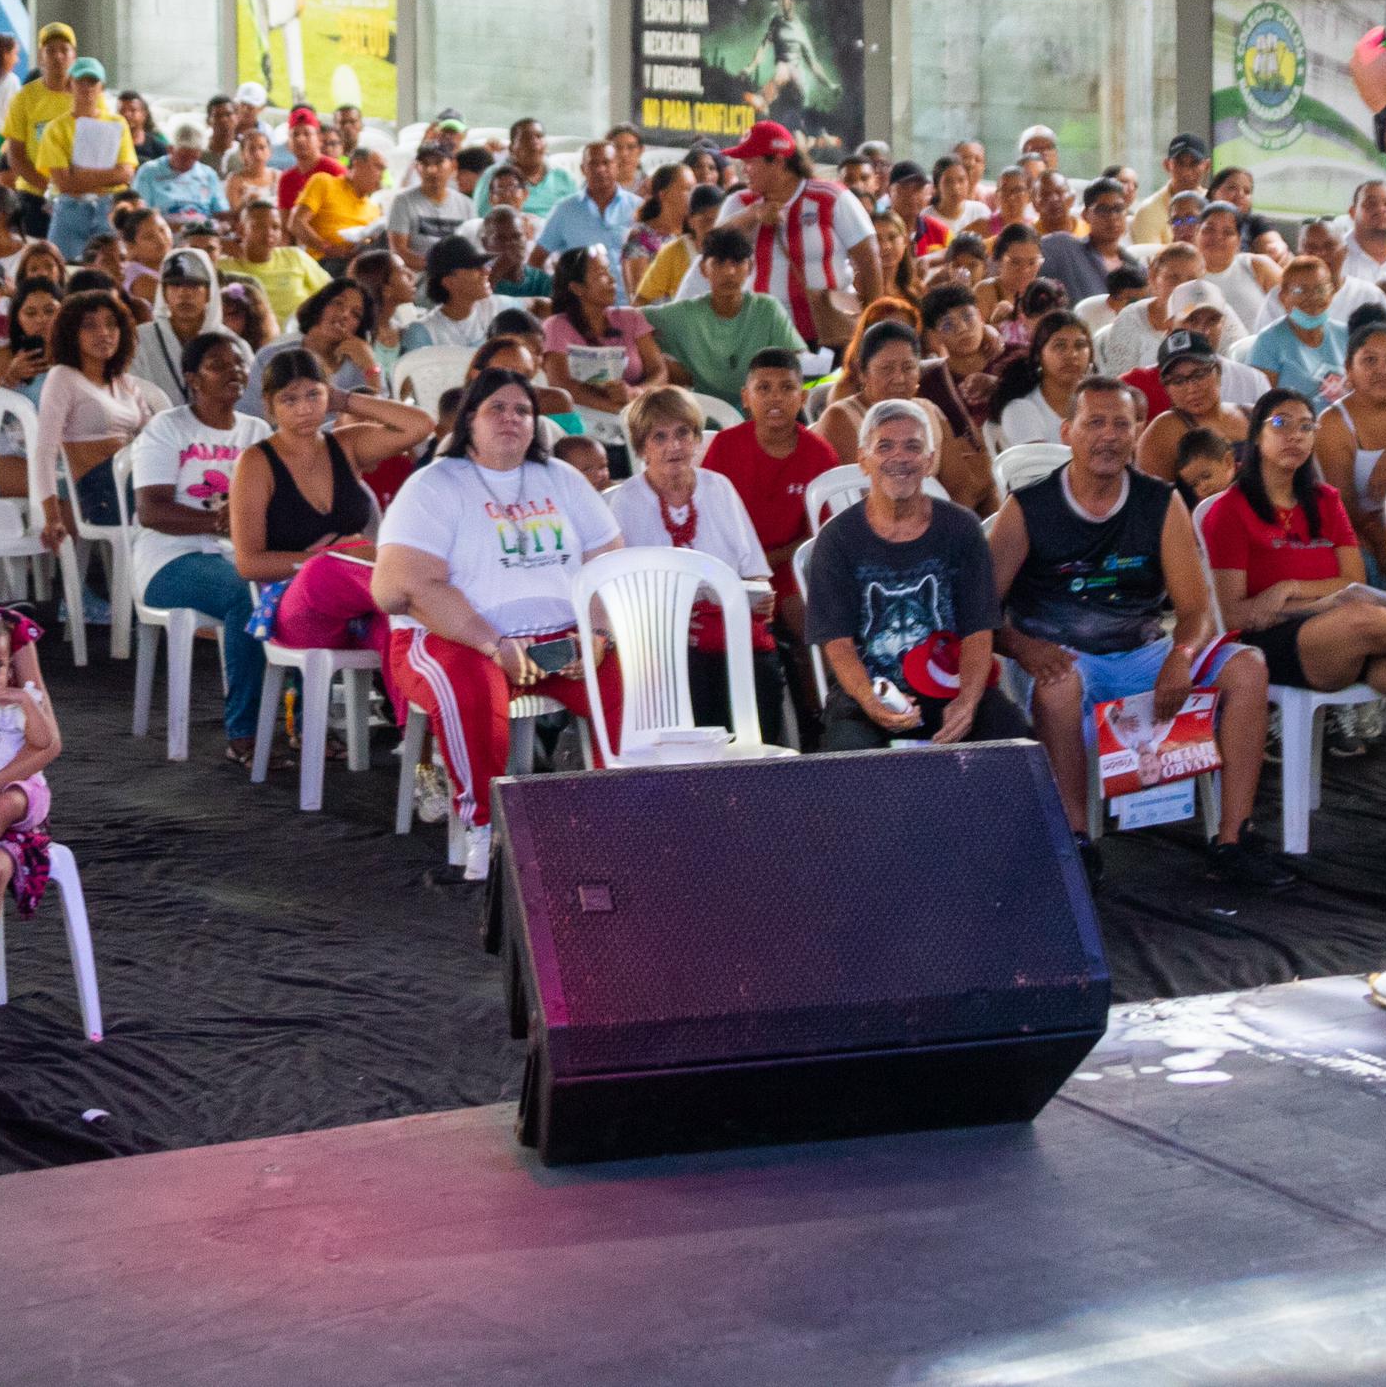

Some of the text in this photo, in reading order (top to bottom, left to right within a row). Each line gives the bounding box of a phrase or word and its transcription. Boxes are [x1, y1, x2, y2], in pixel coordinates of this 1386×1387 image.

[1236, 5, 1275, 56] COLEGIO
[642, 96, 661, 128] NO
[661, 98, 693, 131] PARA
[496, 516, 564, 554] CTY
